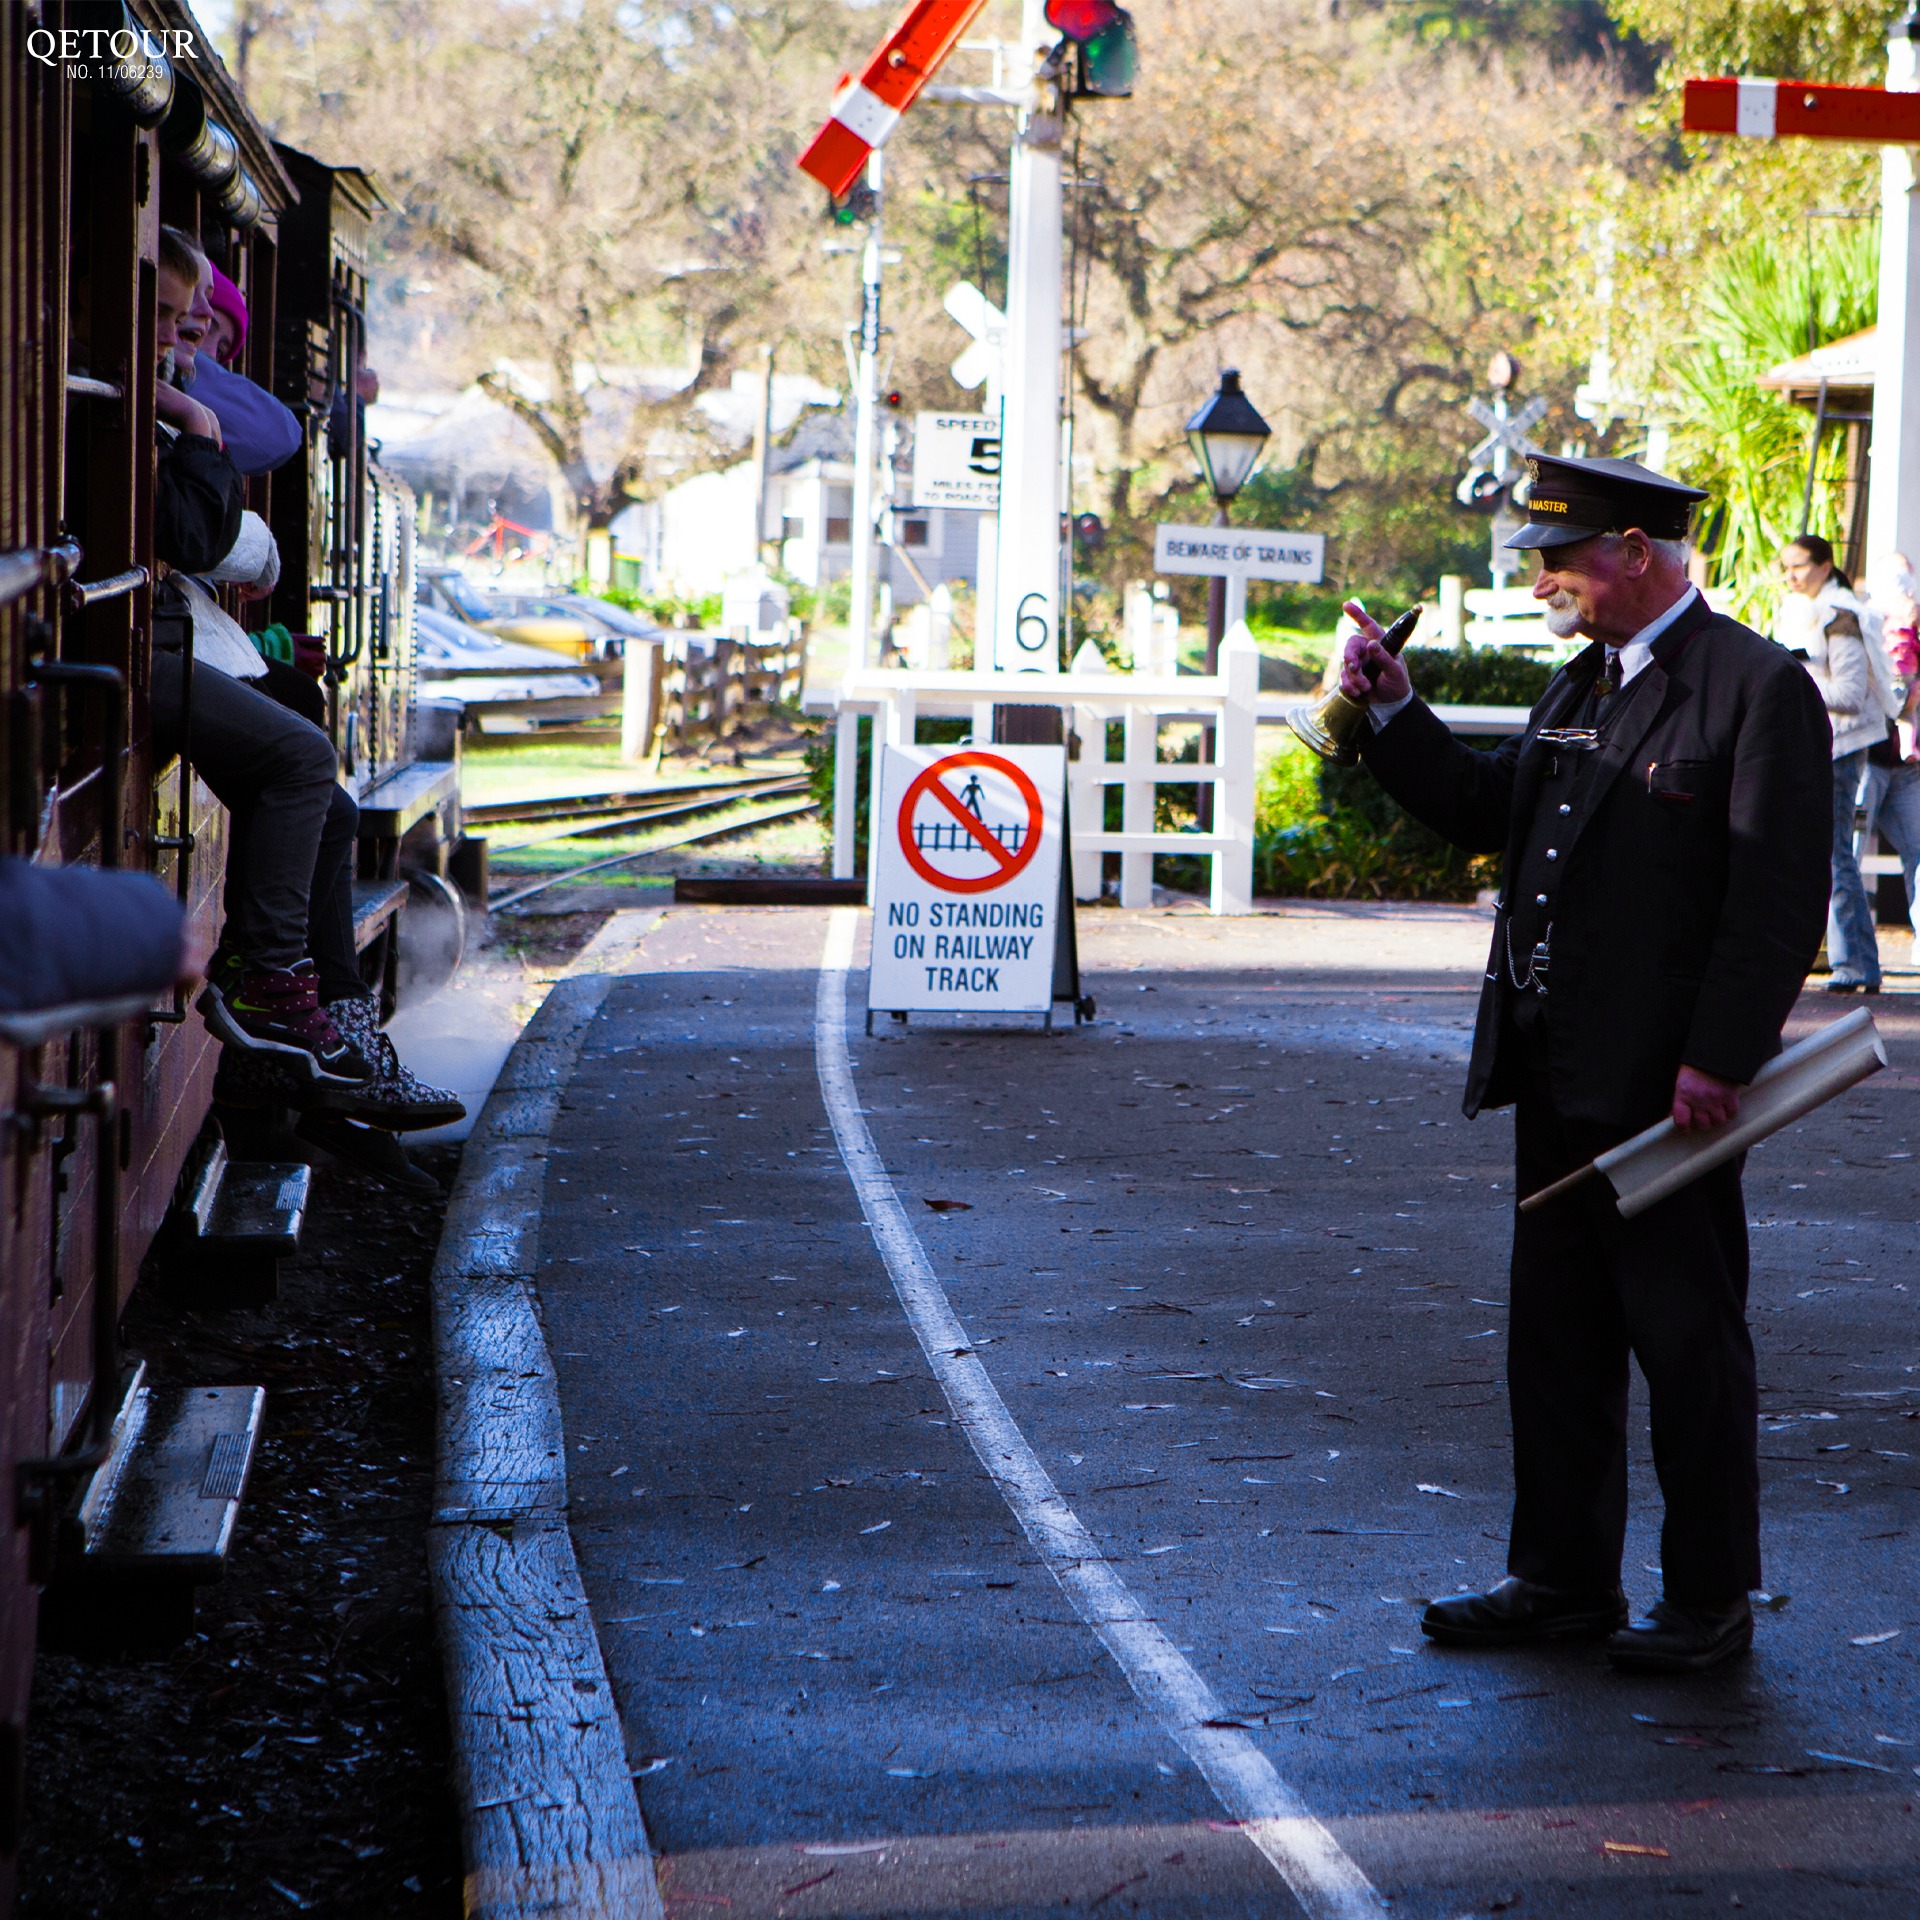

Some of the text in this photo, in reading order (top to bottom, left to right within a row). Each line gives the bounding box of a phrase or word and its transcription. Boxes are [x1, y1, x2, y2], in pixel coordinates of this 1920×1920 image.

[936, 419, 996, 431] SPEED
[968, 437, 1001, 475] 5
[979, 482, 1000, 490] PE
[1533, 500, 1568, 513] MASTER
[1167, 539, 1312, 565] BEWARE OF TRAINS
[1016, 592, 1048, 651] 6
[888, 902, 1043, 928] NO STANDING
[894, 934, 1034, 960] ON RAILWAY
[925, 966, 999, 992] TRACK
